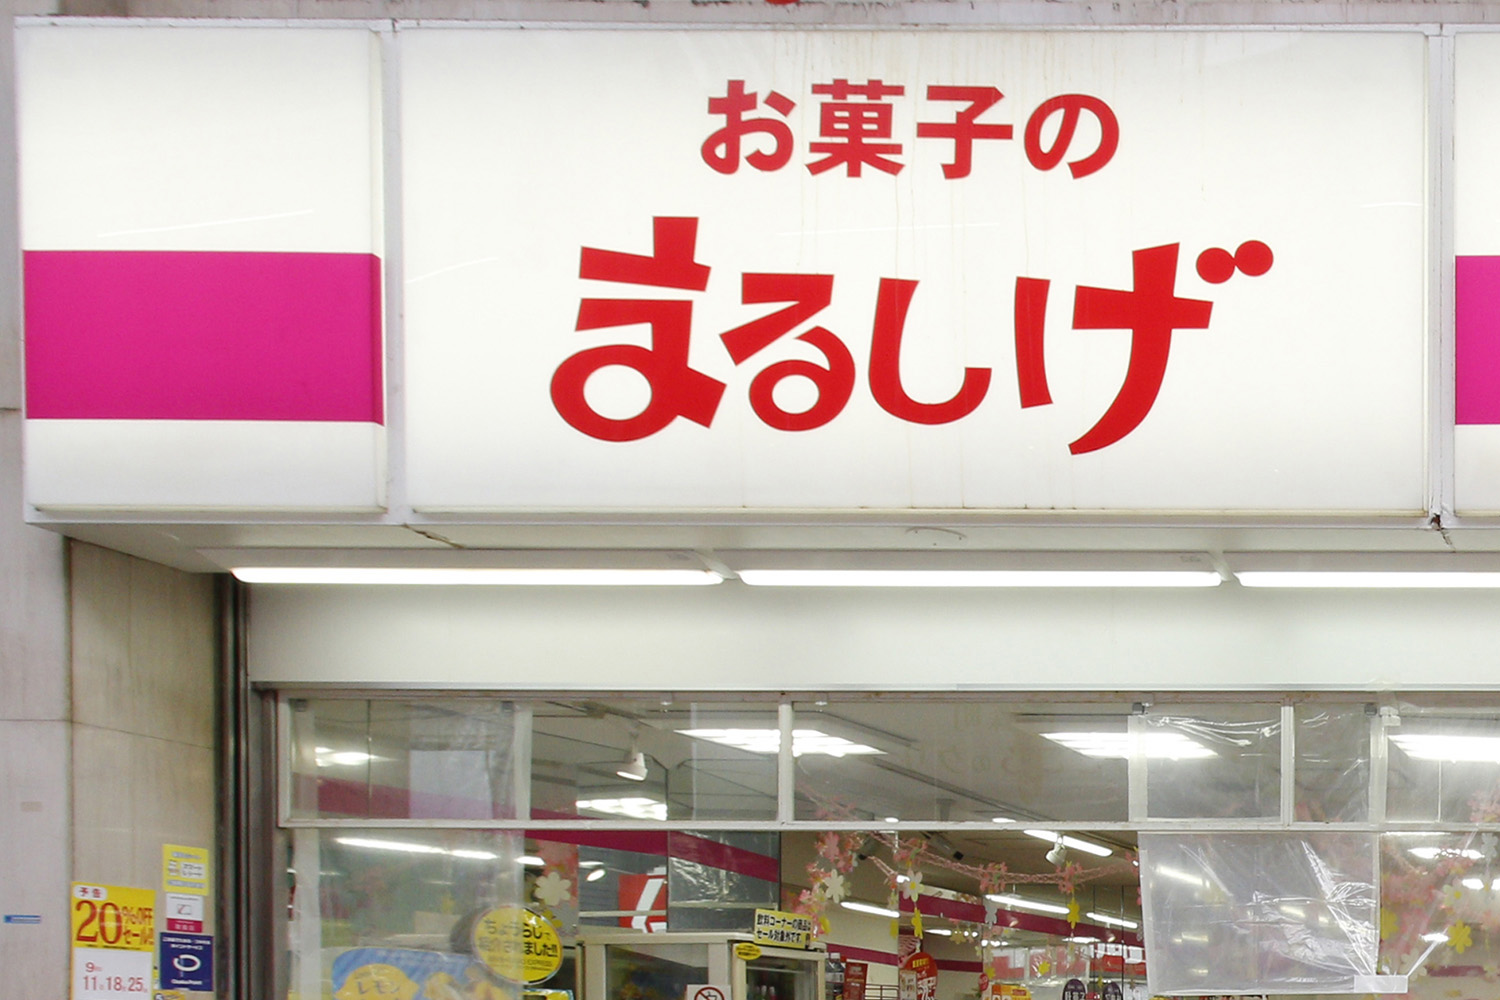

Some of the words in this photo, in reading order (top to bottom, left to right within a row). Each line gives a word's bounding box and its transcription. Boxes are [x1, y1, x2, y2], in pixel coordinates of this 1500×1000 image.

[700, 78, 1121, 180] お菓子の
[549, 215, 1275, 456] まるしげ
[79, 886, 103, 899] 予告
